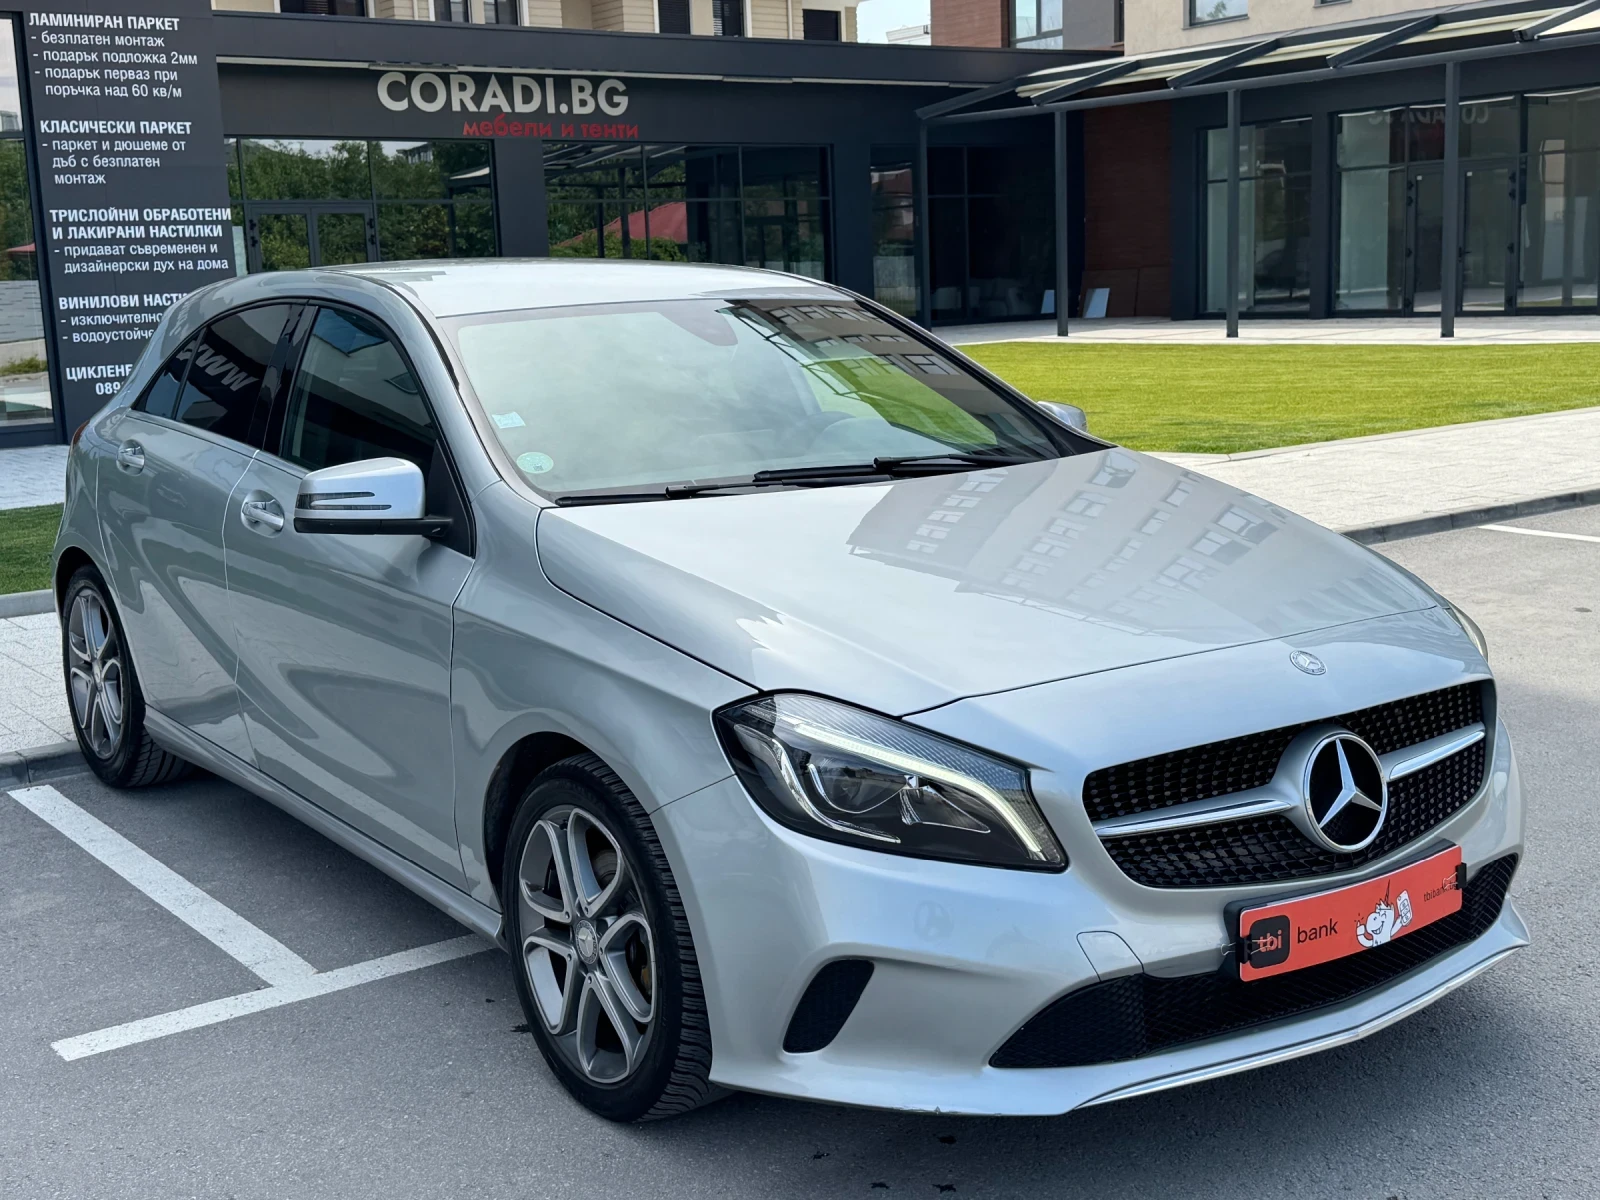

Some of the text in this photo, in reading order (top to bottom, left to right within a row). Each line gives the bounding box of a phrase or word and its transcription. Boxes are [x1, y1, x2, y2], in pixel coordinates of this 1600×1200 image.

[29, 13, 179, 30] ЛАМИНИРАН ПАРКЕТ
[42, 31, 110, 45] безплатен
[115, 36, 164, 46] монтаж
[44, 51, 98, 64] подарък
[103, 53, 167, 63] подложка
[171, 52, 197, 64] 2мм
[45, 68, 100, 81] подарък
[105, 70, 150, 81] перваз
[155, 71, 177, 82] при
[46, 84, 181, 98] поръчка над 60 кв/м
[377, 71, 628, 116] CORADI.BG
[41, 120, 191, 134] КЛАСИЧЕСКИ ПАРКЕТ
[463, 114, 639, 139] мебели и тенти
[53, 141, 97, 152] паркет
[102, 141, 109, 150] и
[114, 141, 168, 151] дюшеме
[172, 141, 185, 150] от
[53, 155, 160, 168] дъб с безплатен
[55, 174, 106, 184] монтаж
[50, 207, 231, 222] ТРИСЛОЙНИ ОБРАБОТЕНИ
[52, 225, 222, 239] И ЛАКИРАНИ НАСТИЛКИ
[65, 246, 125, 258] придават
[130, 244, 206, 256] съвременен
[210, 244, 217, 253] и
[65, 260, 228, 274] дизайнерски дух на дома
[59, 295, 139, 309] ВИНИЛОВИ
[1257, 918, 1338, 953] tbi bank
